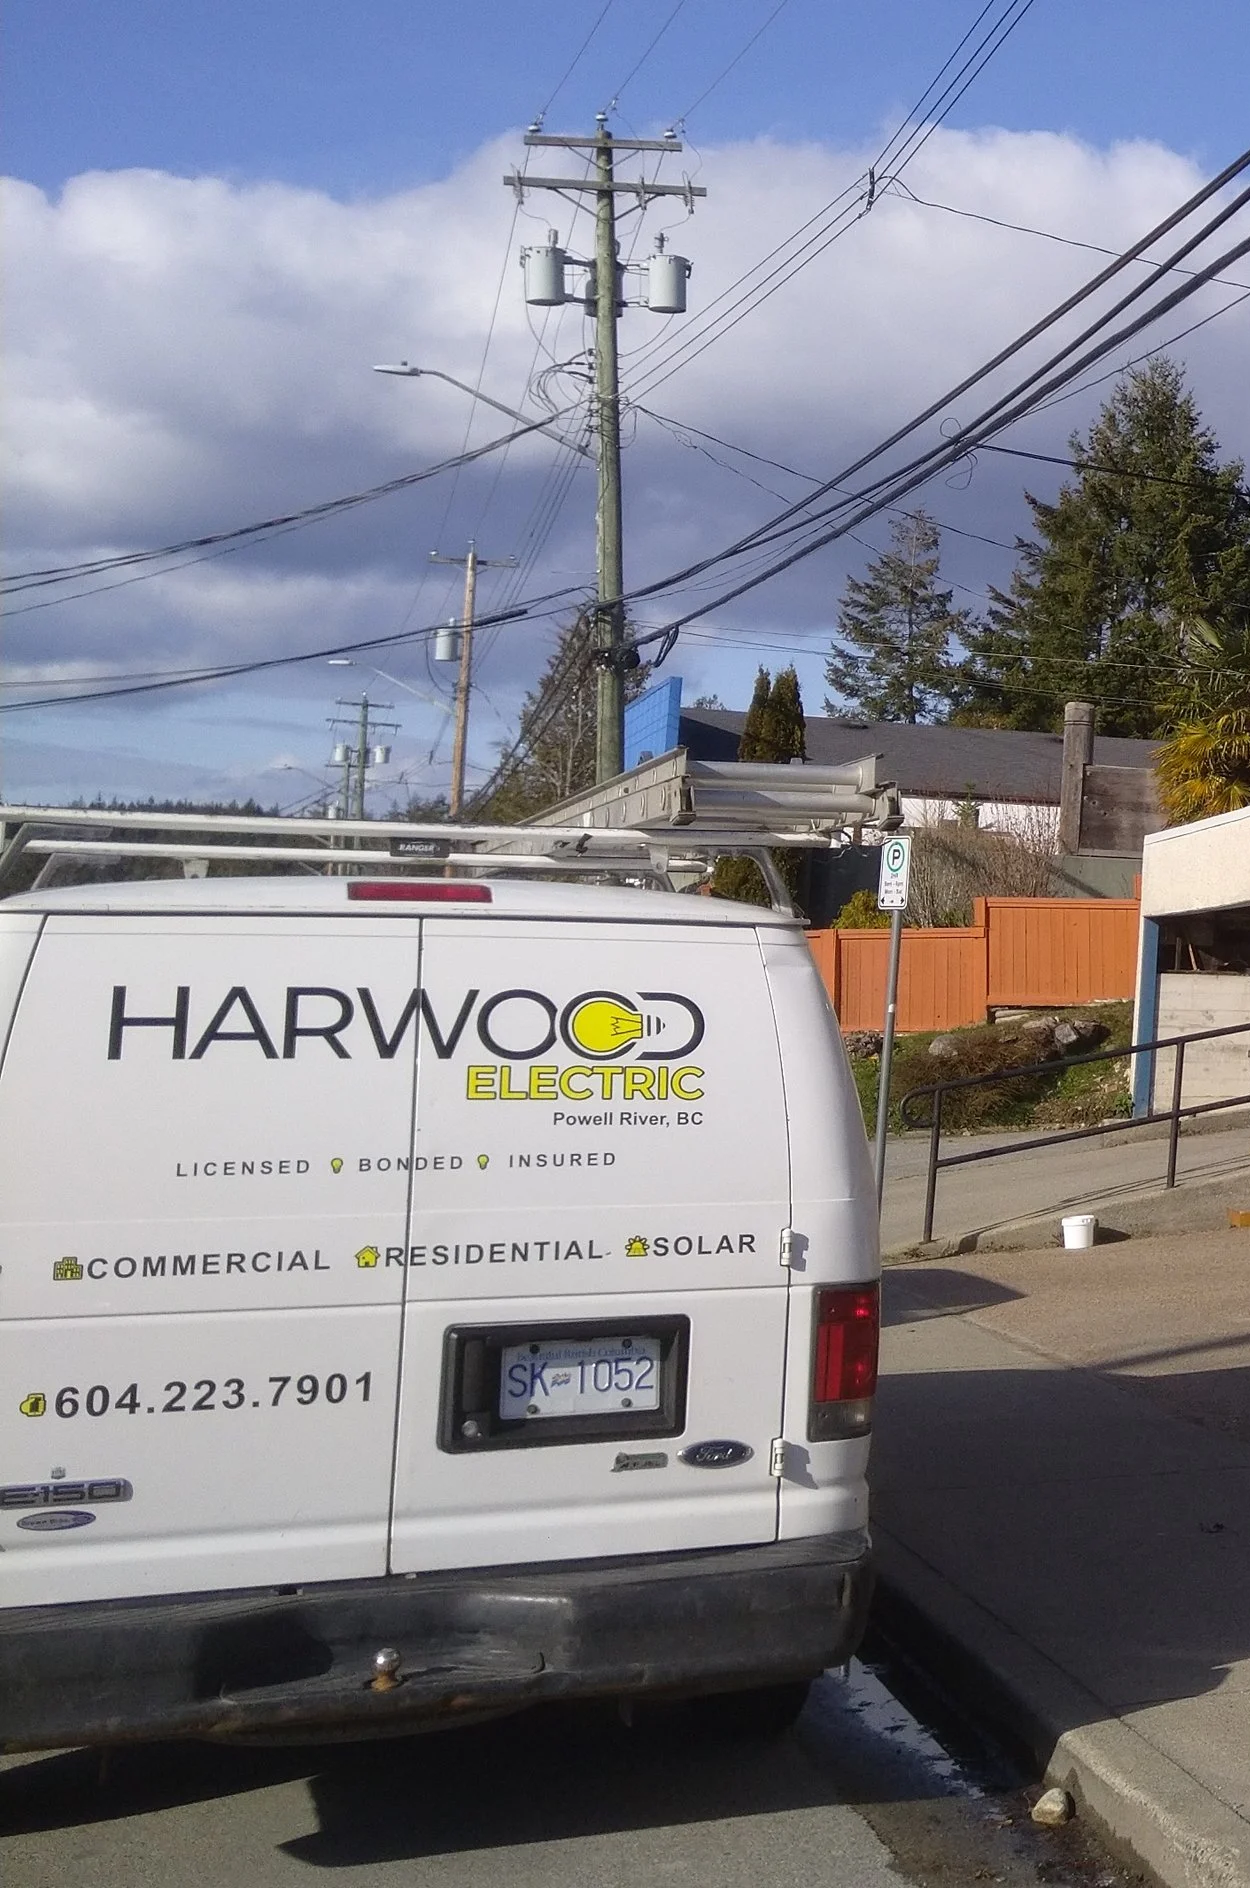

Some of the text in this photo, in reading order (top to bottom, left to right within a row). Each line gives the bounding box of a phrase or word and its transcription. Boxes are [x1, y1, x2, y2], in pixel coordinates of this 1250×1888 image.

[891, 848, 901, 866] P
[107, 985, 705, 1061] HARWOOD
[466, 1065, 705, 1101] ELECTRIC
[553, 1112, 704, 1128] Powell River, BC
[176, 1152, 616, 1177] LICENSED BONDED INSURED
[87, 1234, 757, 1279] COMMERCIAL RESIDENTIAL SOLAR
[55, 1371, 373, 1418] 604.223.7901
[507, 1356, 655, 1398] SK 1052
[696, 1449, 733, 1462] Ford
